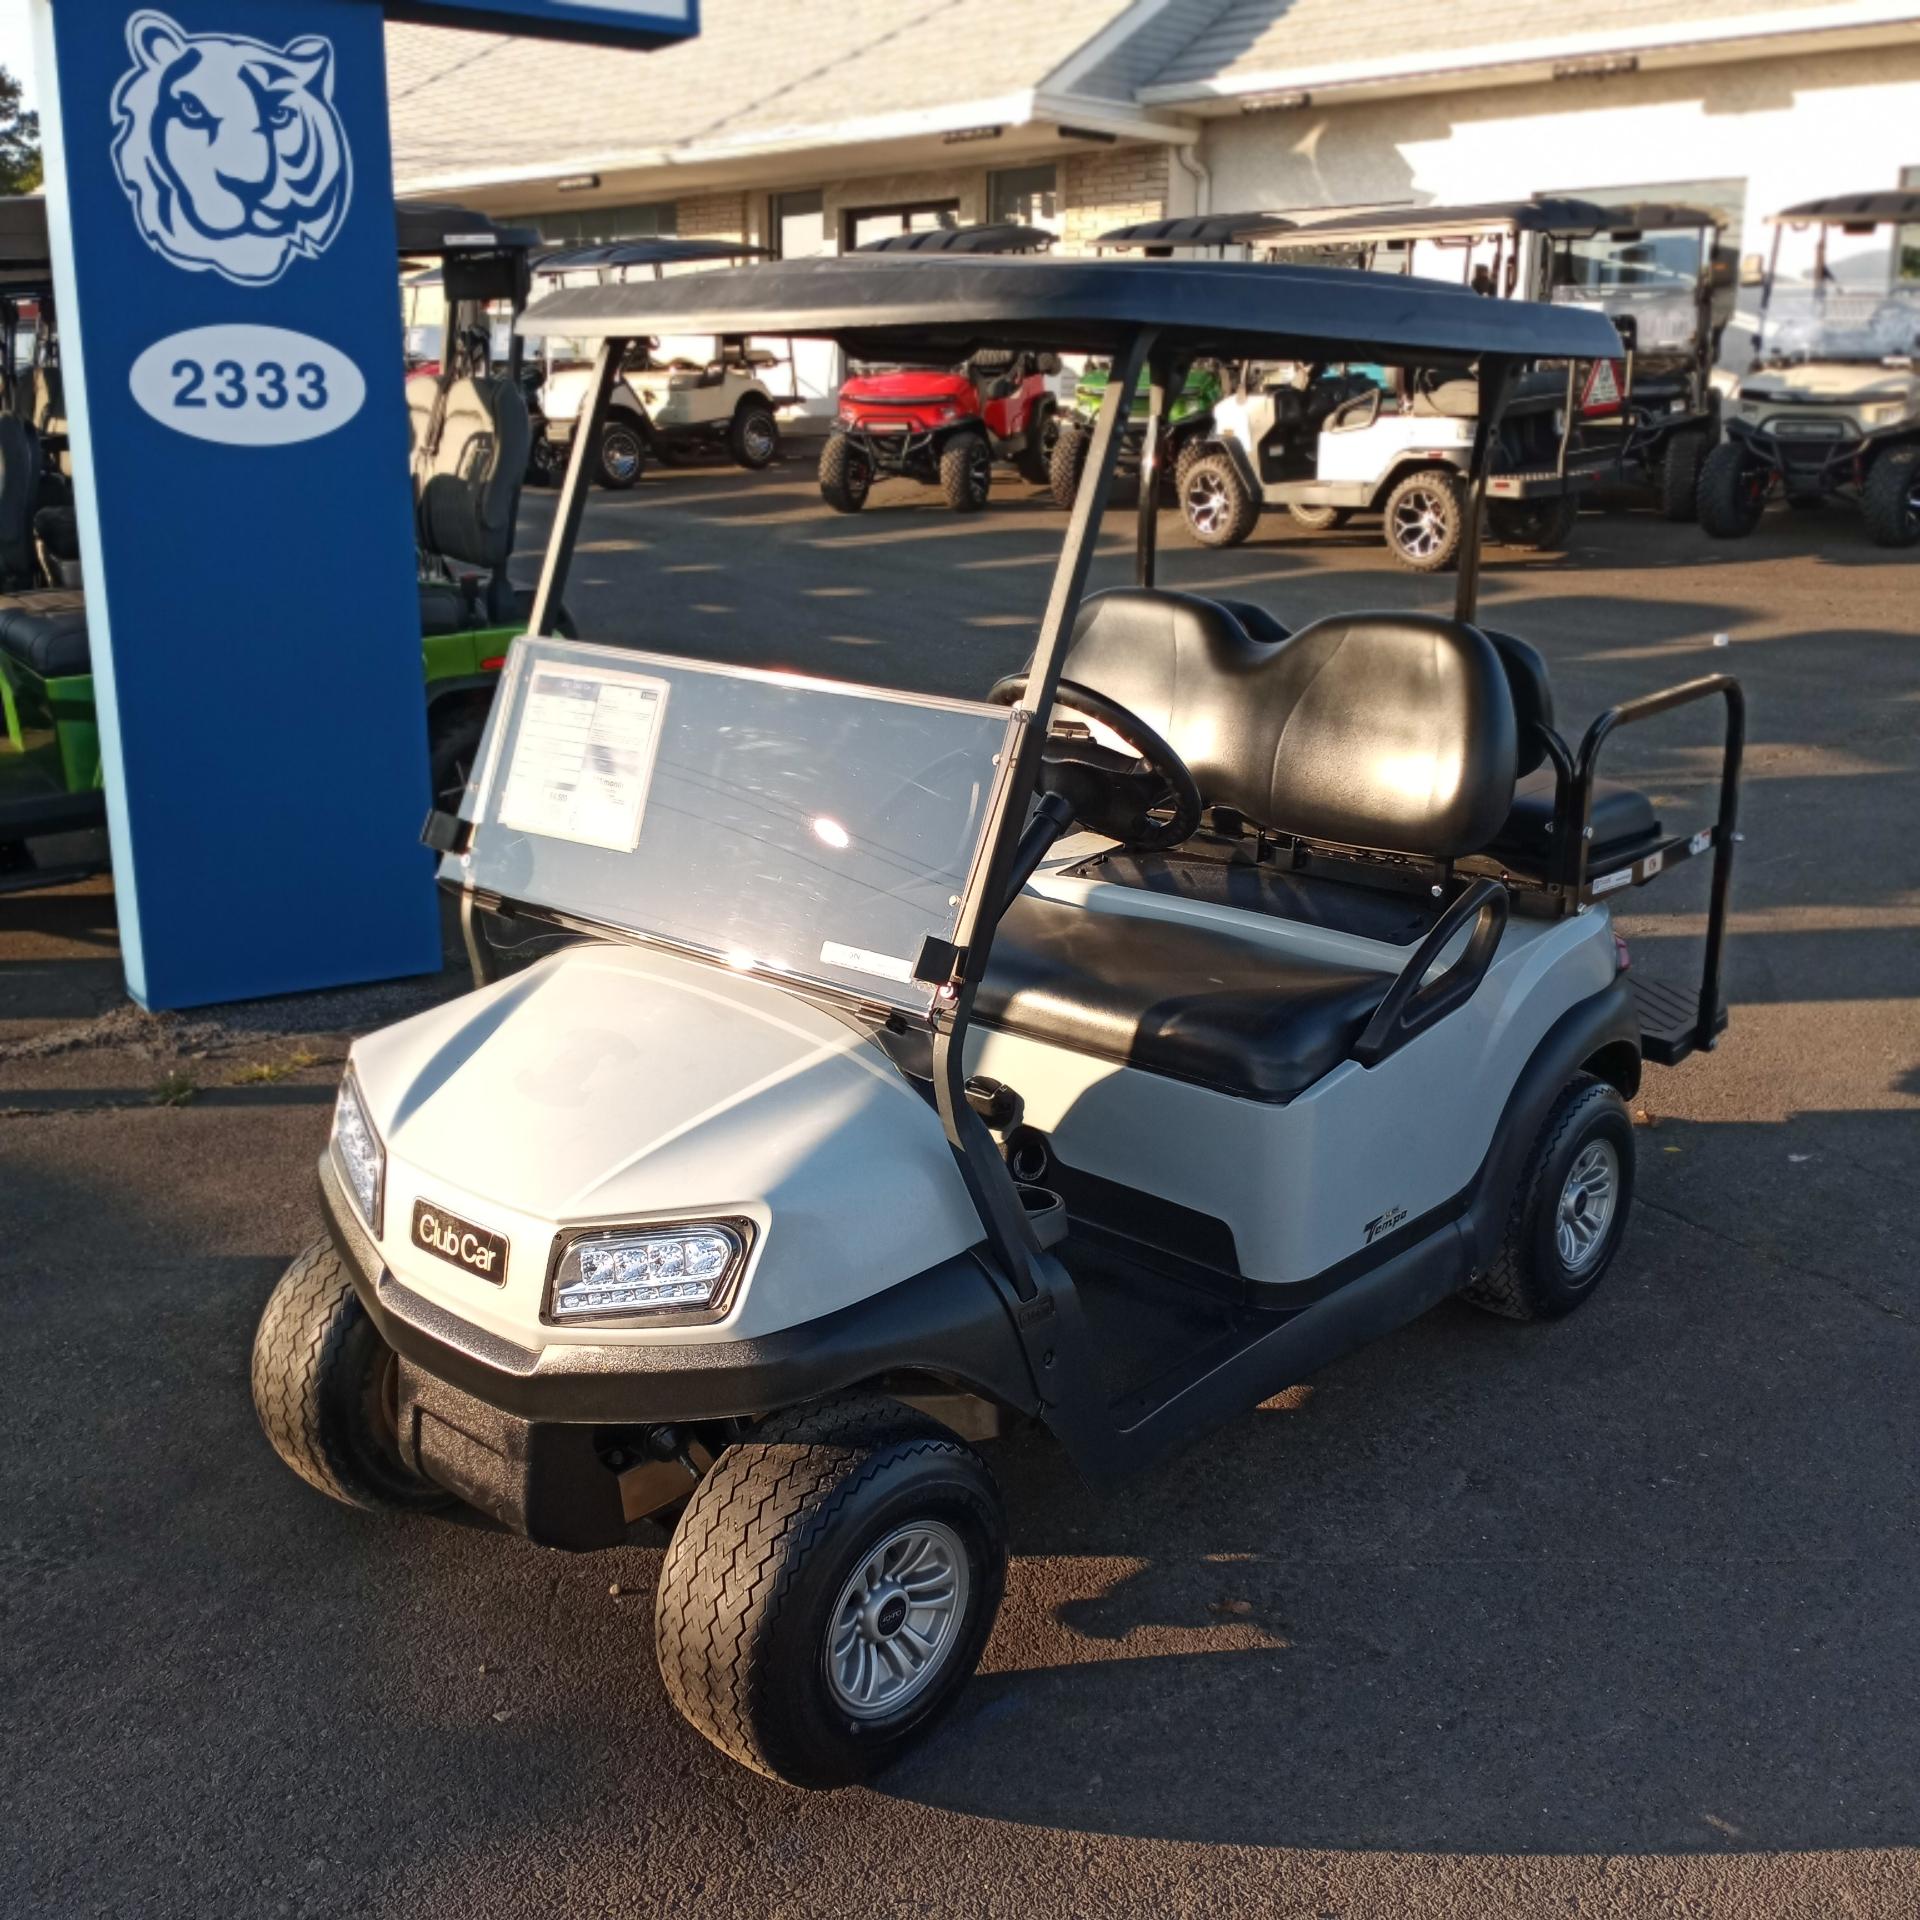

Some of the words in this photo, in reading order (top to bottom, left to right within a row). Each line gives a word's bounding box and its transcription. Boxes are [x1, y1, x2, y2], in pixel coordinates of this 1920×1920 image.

[171, 358, 328, 410] 2333
[420, 1214, 459, 1256] Club
[461, 1234, 496, 1271] Car
[1363, 1209, 1408, 1244] Tempo
